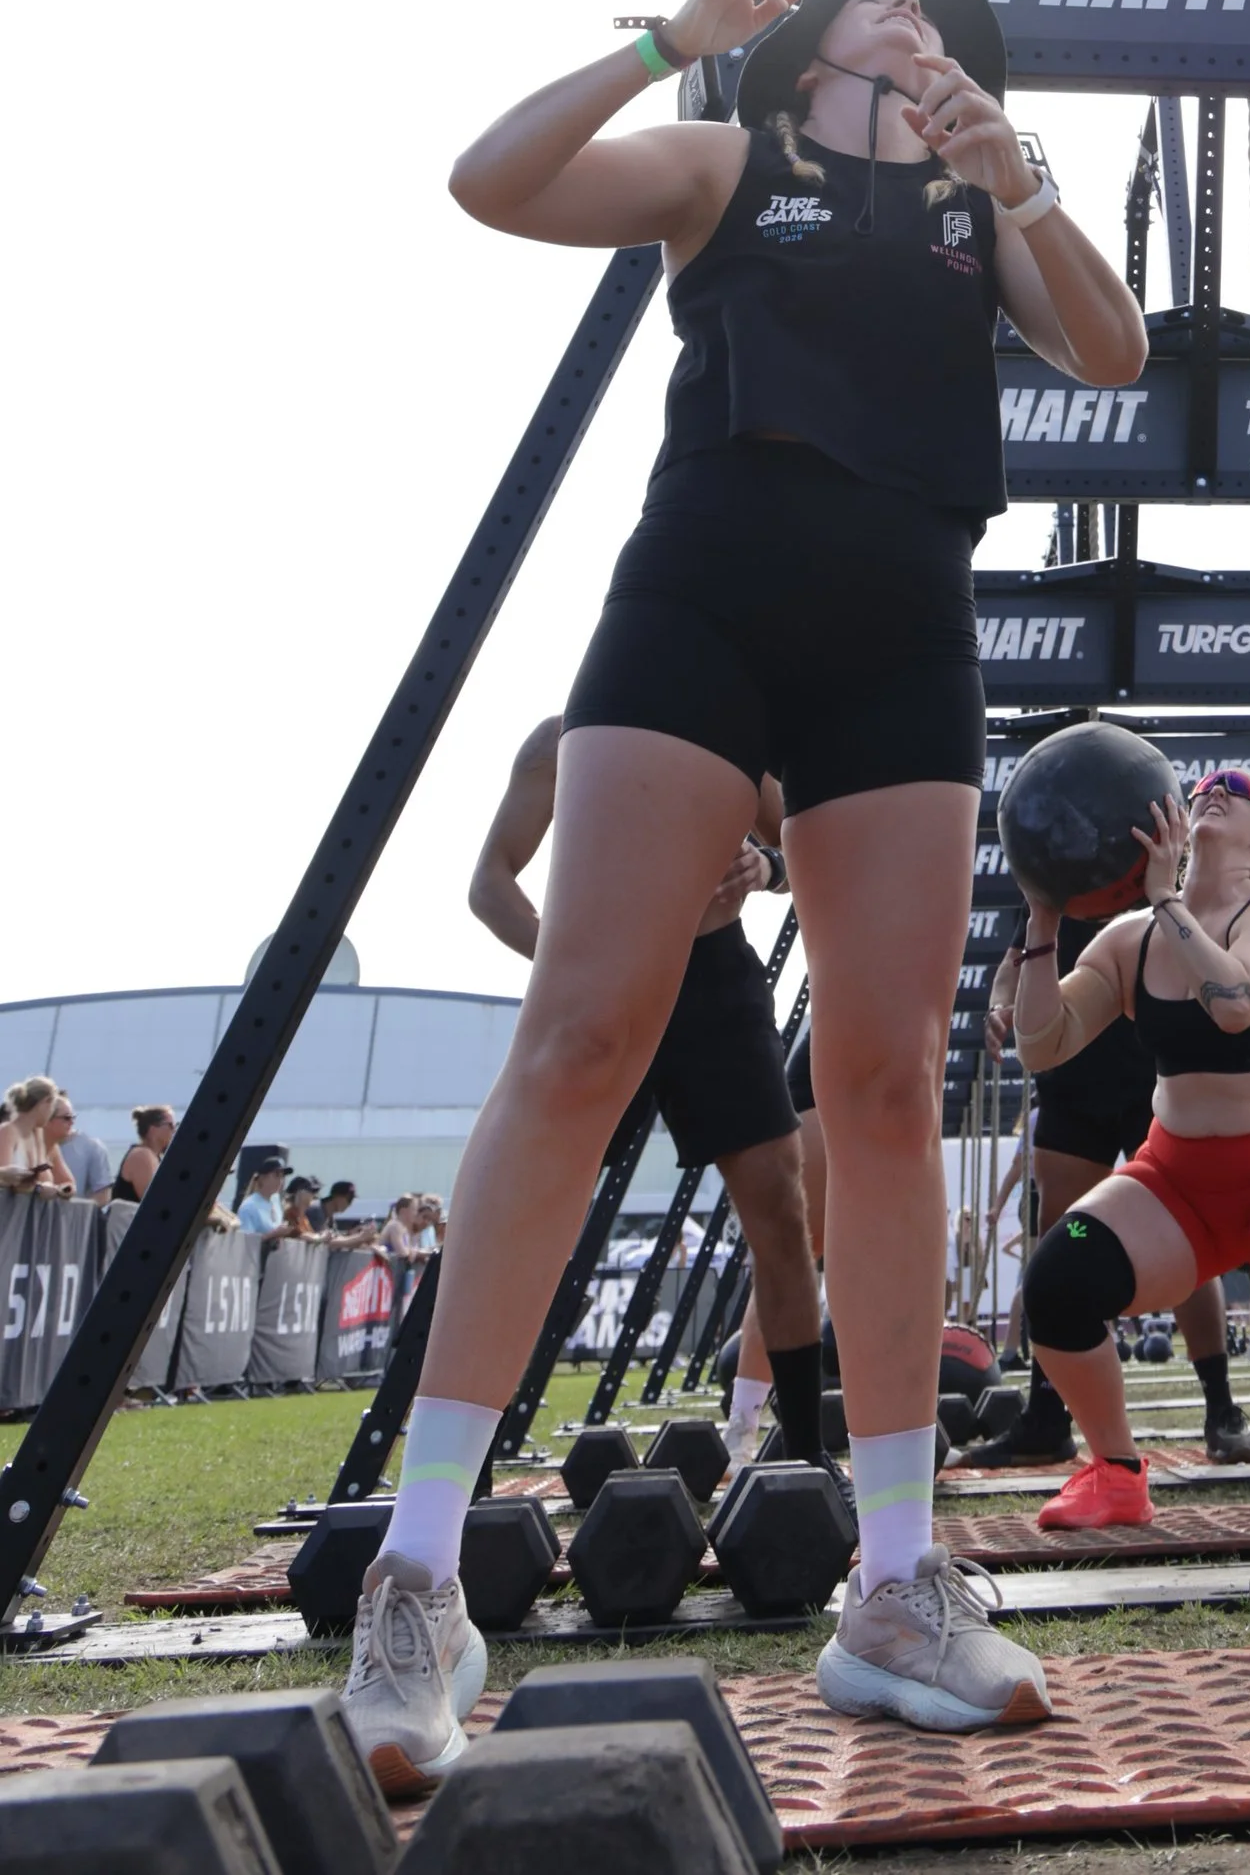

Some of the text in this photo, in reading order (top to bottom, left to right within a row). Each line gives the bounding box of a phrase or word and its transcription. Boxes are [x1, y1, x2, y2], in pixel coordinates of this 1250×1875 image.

[770, 195, 821, 210] TURF
[755, 209, 833, 227] GAMES
[763, 223, 821, 238] GOLD COAST
[930, 244, 982, 273] WELLINGT
[946, 258, 974, 276] POINT
